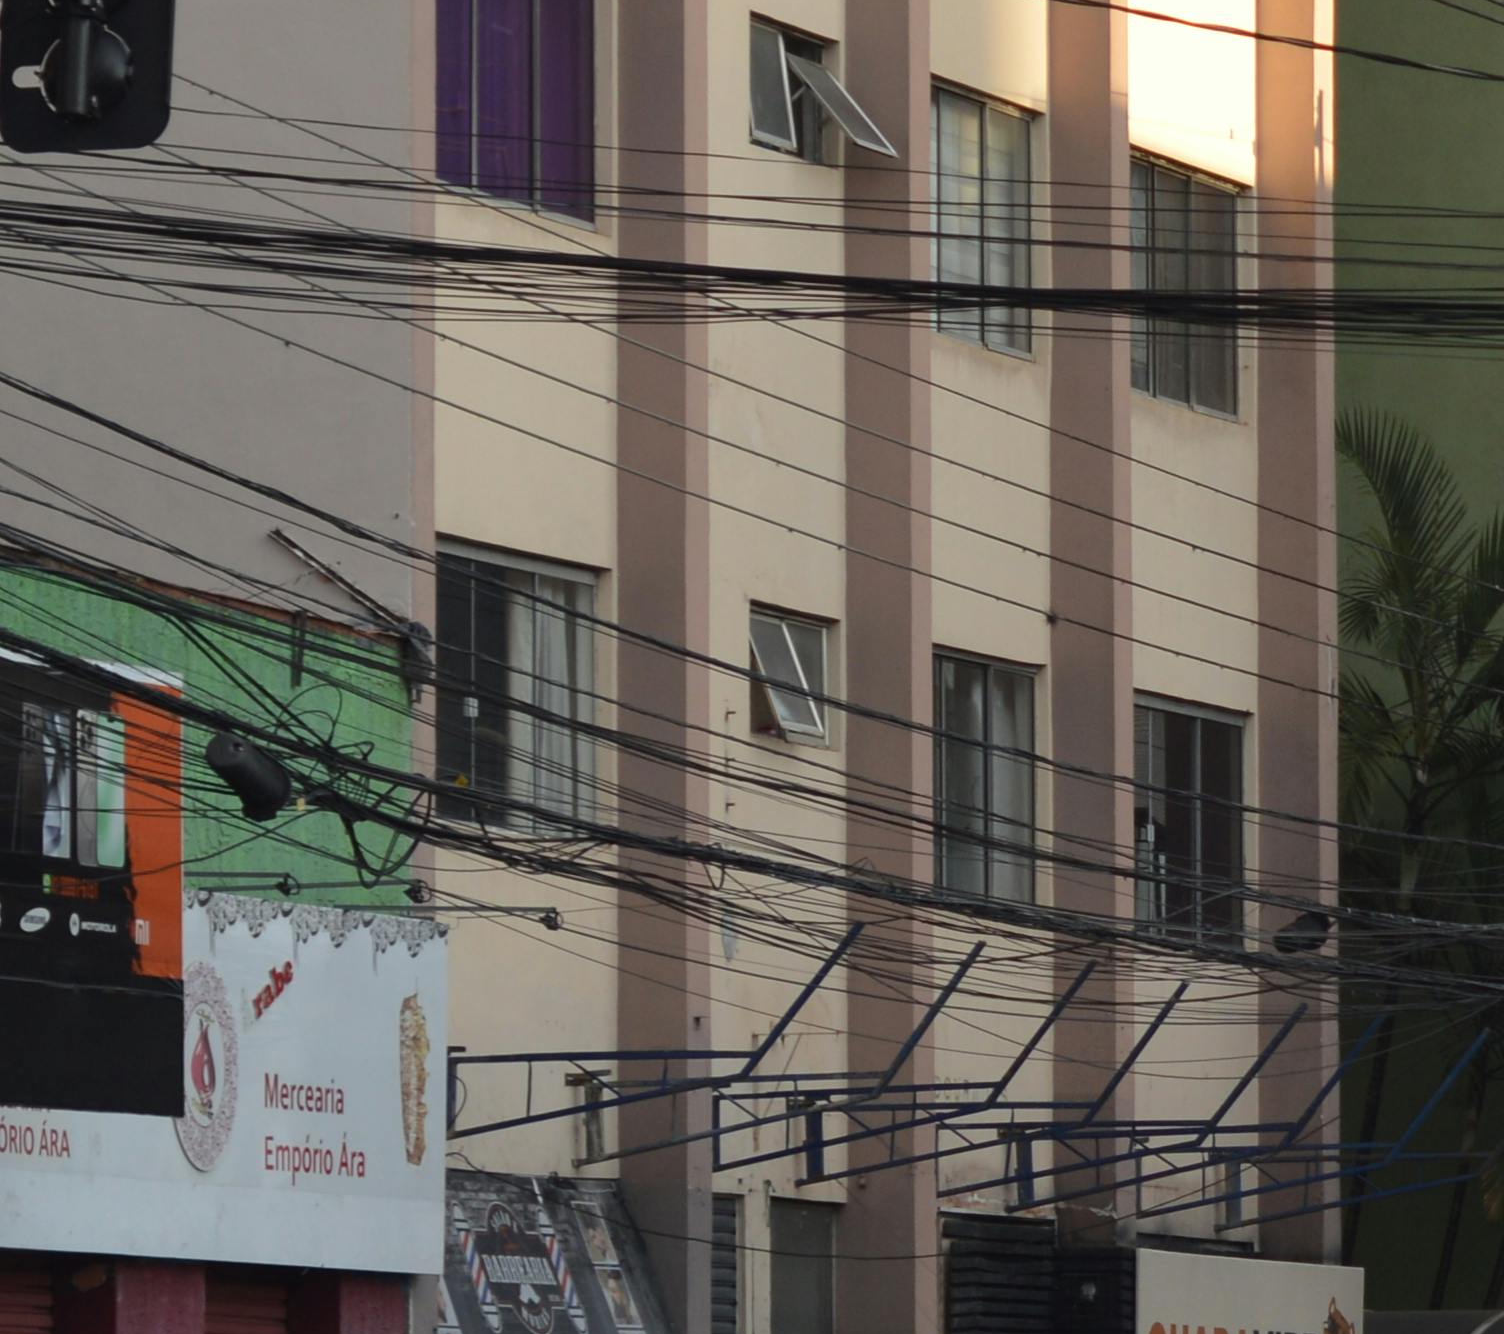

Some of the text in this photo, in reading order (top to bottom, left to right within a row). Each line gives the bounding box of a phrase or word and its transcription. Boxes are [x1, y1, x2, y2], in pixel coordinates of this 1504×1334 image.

[264, 1073, 344, 1114] Mercearia
[39, 1120, 71, 1158] ÁRA
[264, 1132, 366, 1185] Empório Ára
